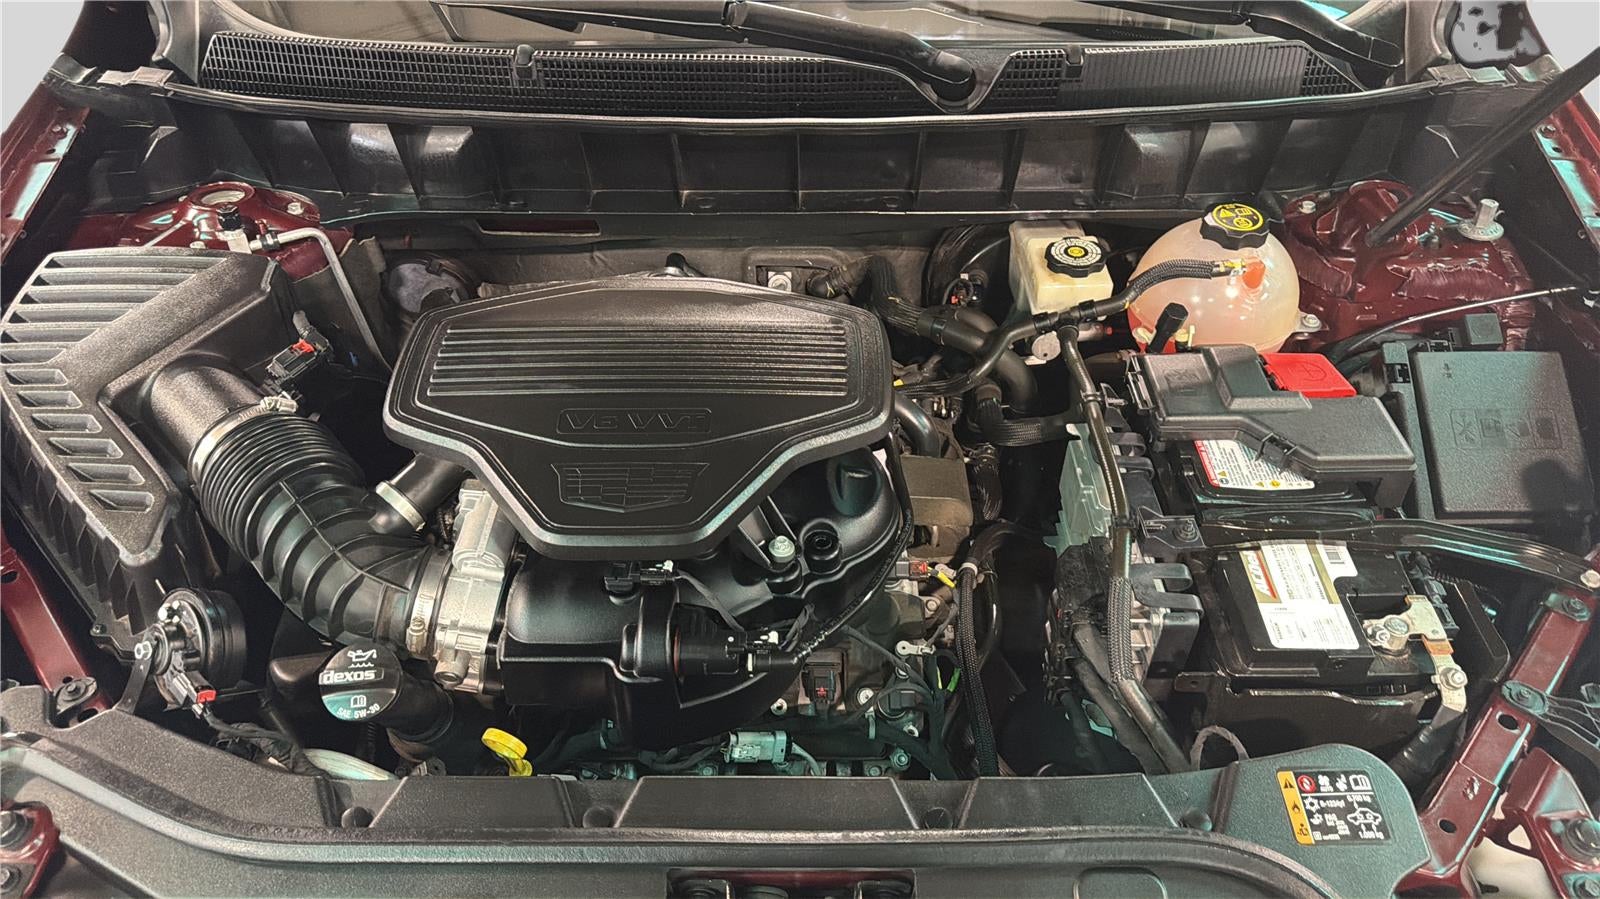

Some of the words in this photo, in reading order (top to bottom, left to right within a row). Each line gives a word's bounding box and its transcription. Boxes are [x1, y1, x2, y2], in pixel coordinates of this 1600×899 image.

[566, 412, 619, 430] V6
[626, 412, 708, 430] VVT
[323, 670, 377, 684] dexos
[337, 707, 352, 718] SAE
[354, 703, 380, 719] 5W-30
